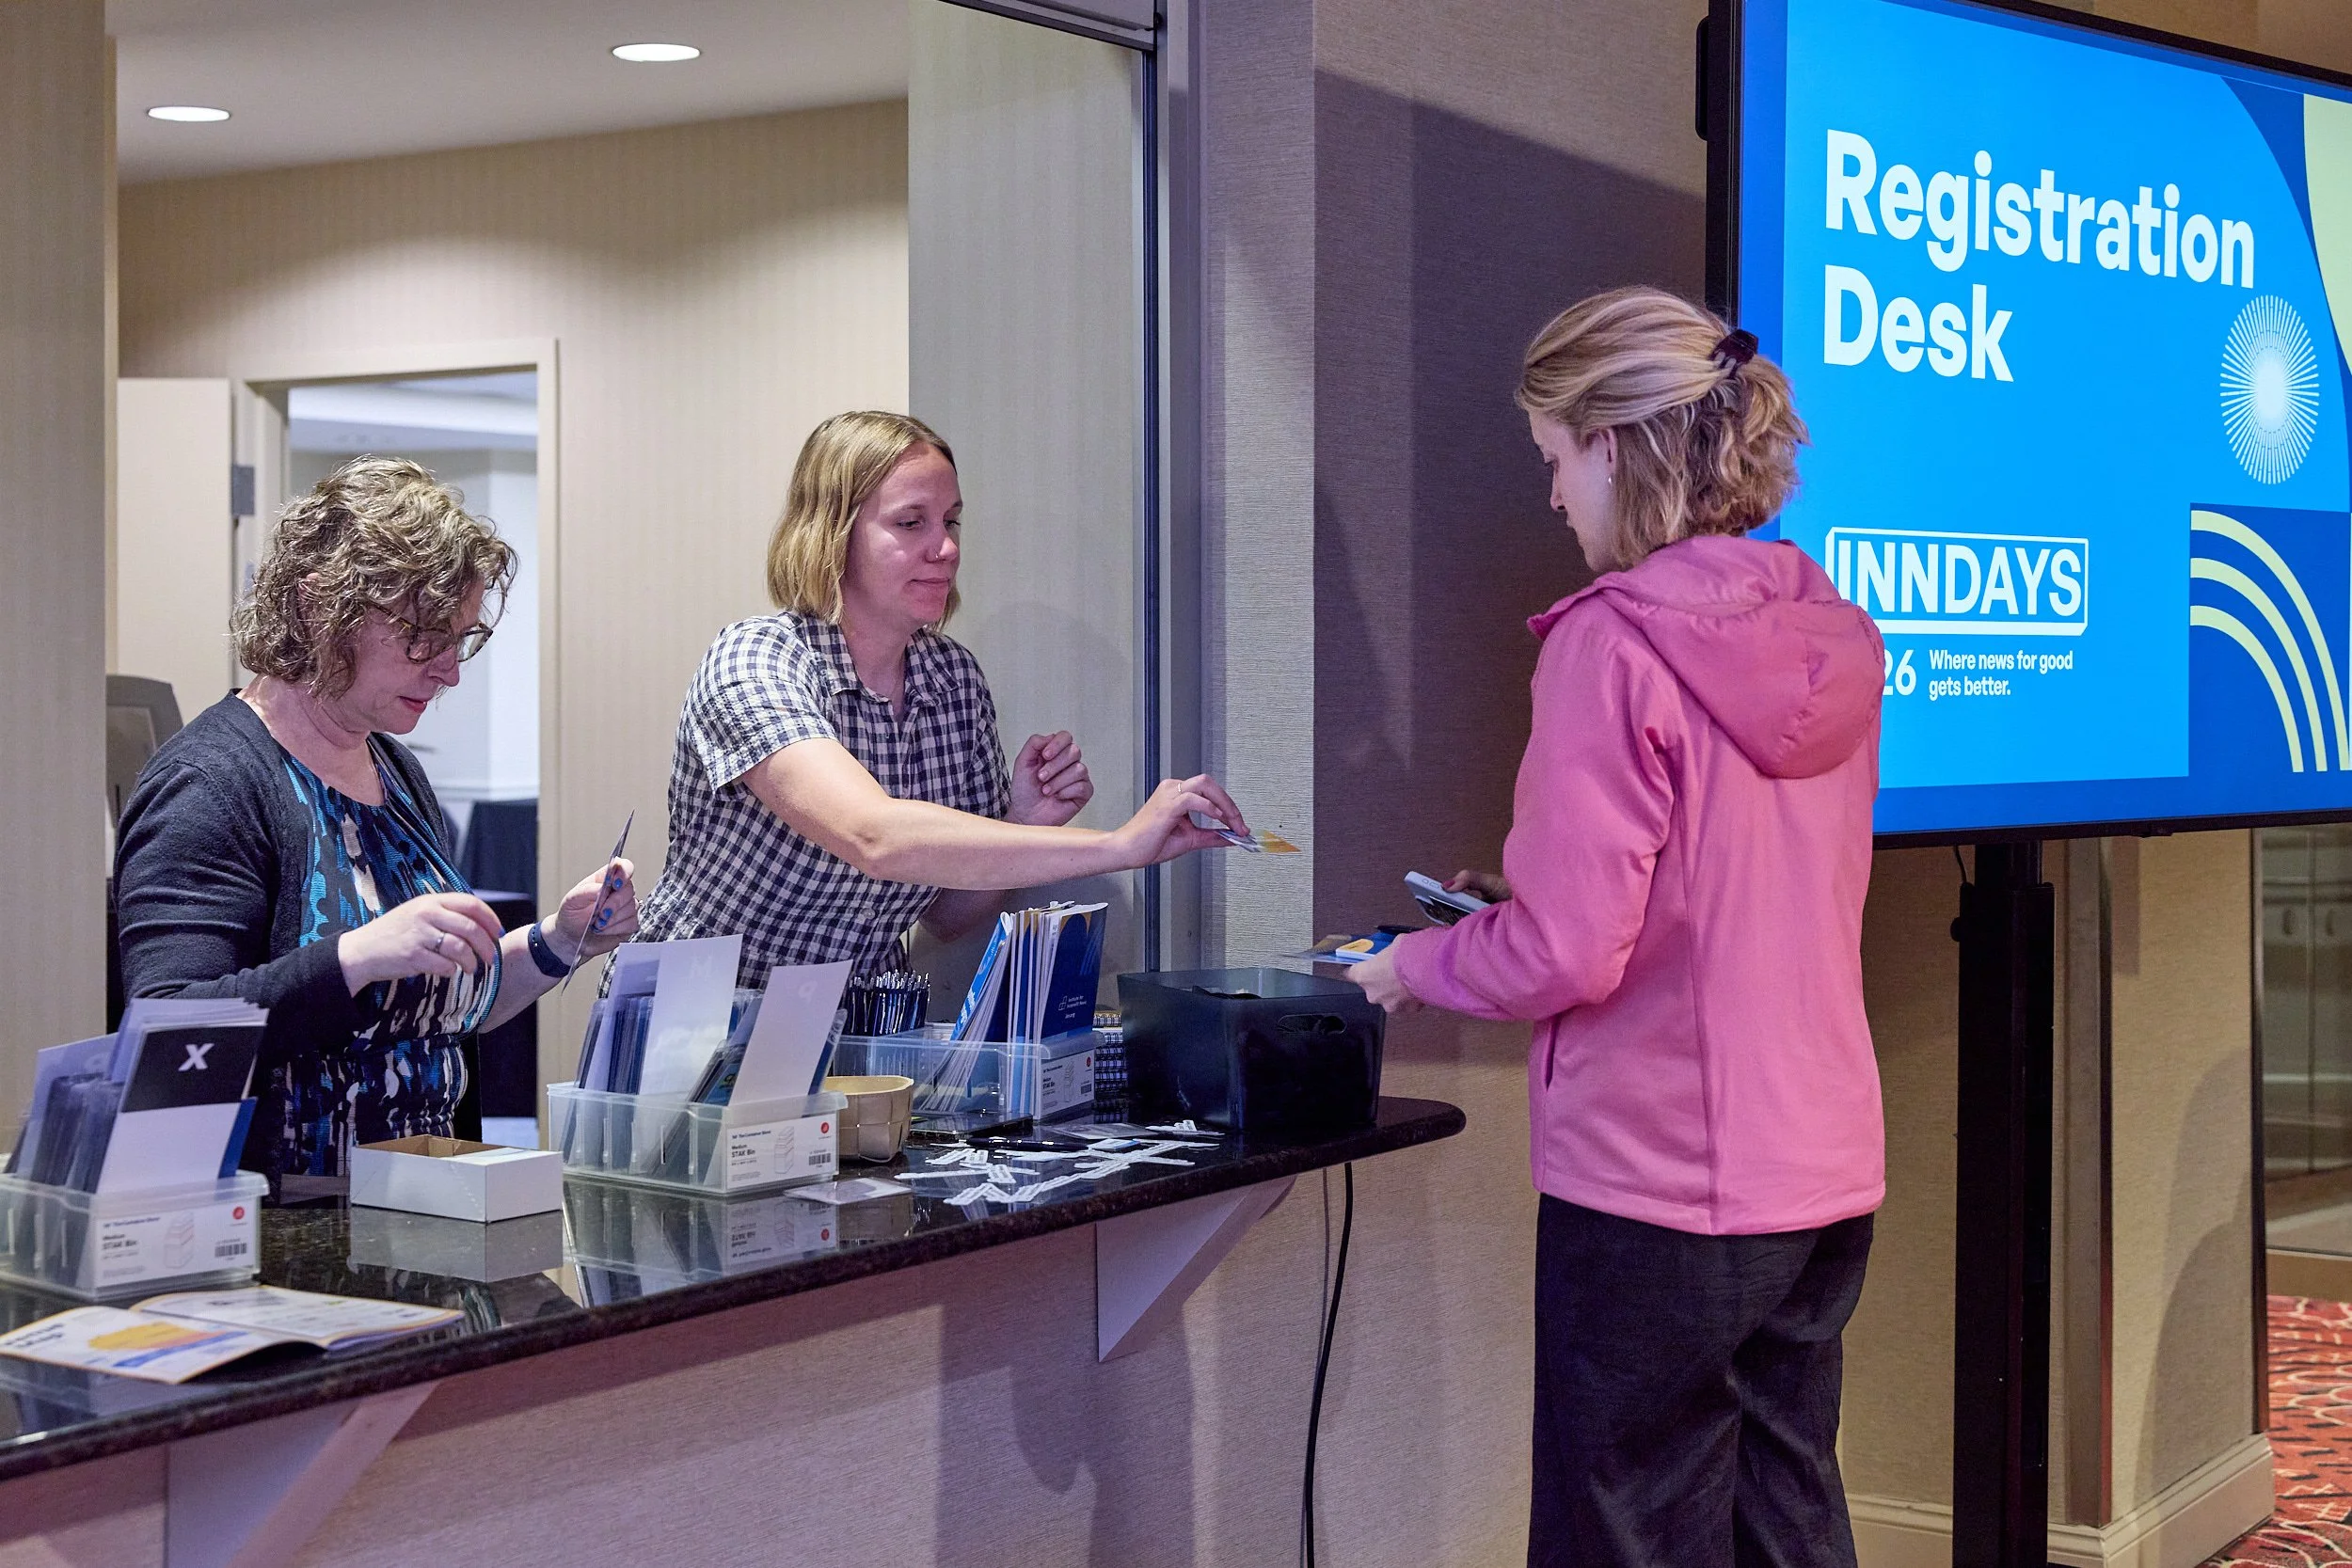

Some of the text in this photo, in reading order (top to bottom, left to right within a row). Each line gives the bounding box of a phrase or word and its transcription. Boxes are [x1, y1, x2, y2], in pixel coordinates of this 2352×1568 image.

[1825, 129, 2254, 289] Registration
[1823, 263, 2014, 382] Desk
[1837, 540, 2082, 617] INNDAYS
[1929, 649, 2074, 674] Where news for good
[1929, 676, 2011, 701] gets better.
[178, 1043, 215, 1071] X
